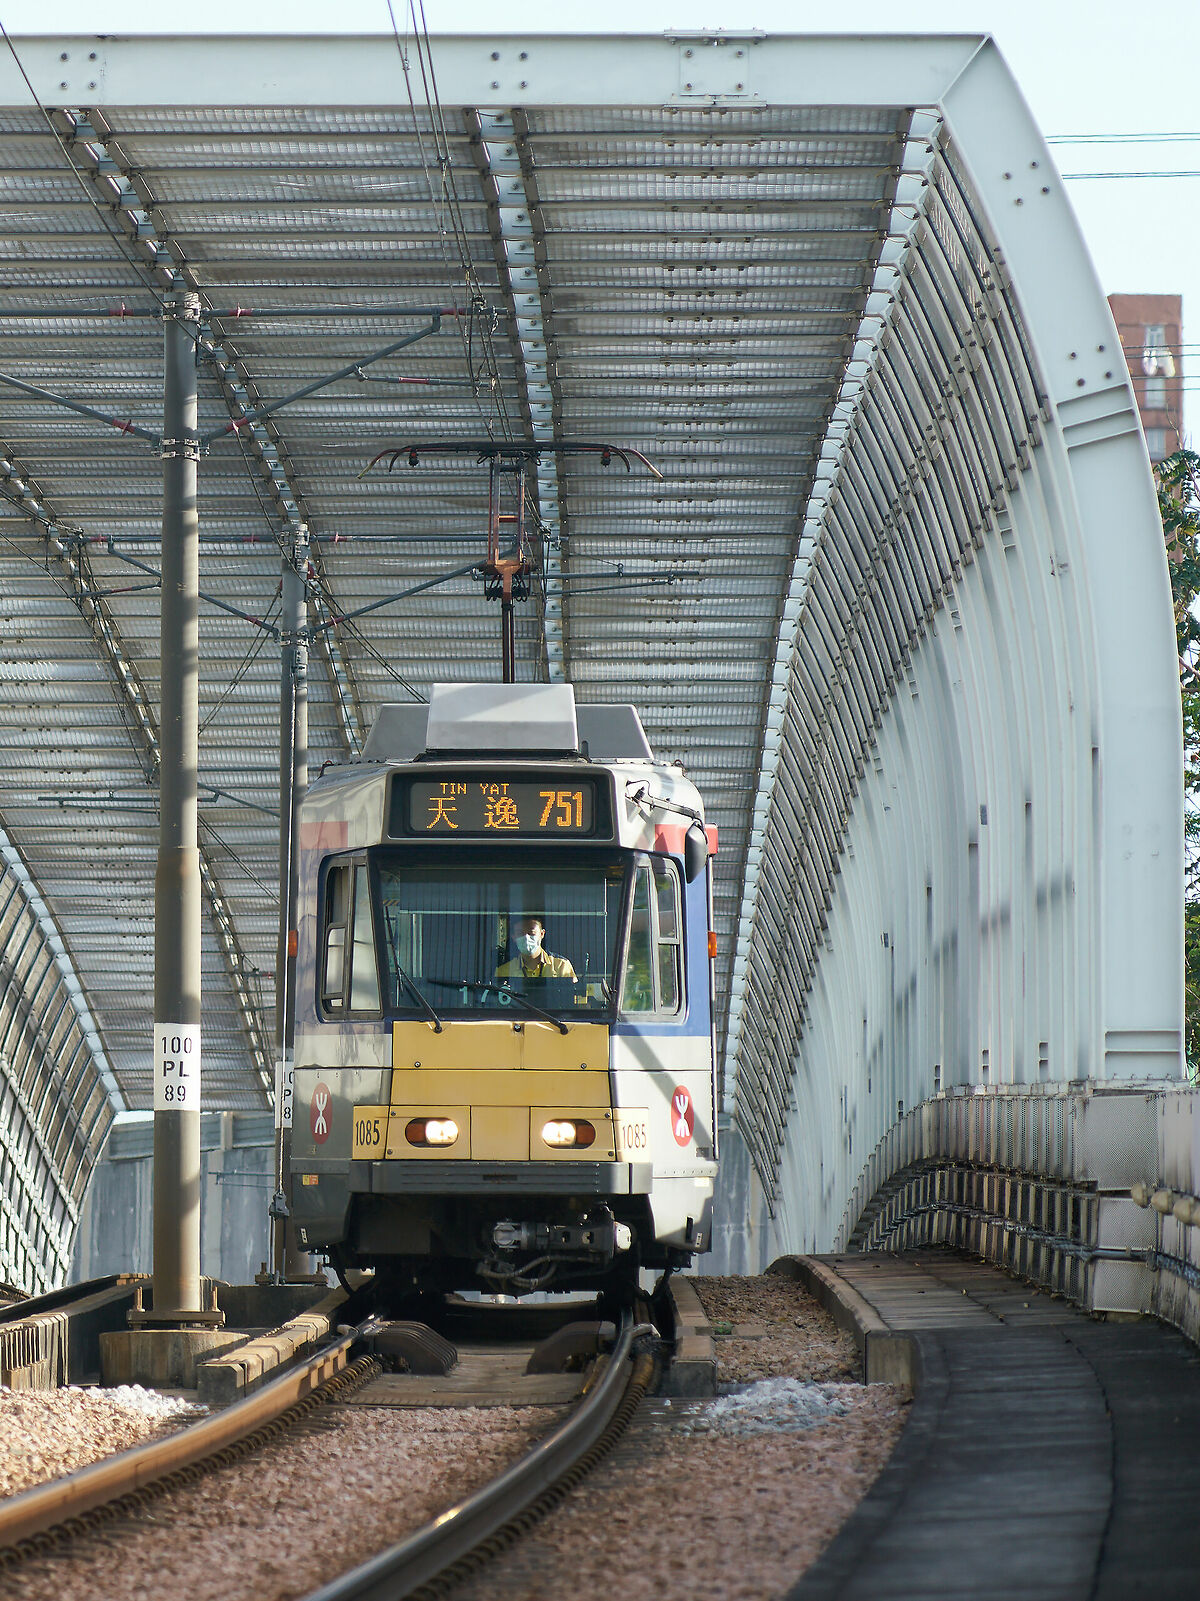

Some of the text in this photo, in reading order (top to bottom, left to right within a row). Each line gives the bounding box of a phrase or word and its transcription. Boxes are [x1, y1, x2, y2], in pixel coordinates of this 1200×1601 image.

[440, 782, 509, 795] TIN YAT
[538, 791, 583, 827] 751
[161, 1036, 193, 1054] 100
[163, 1060, 190, 1077] PL
[164, 1084, 186, 1102] 89
[355, 1119, 380, 1146] 1085
[622, 1123, 647, 1149] 1085
